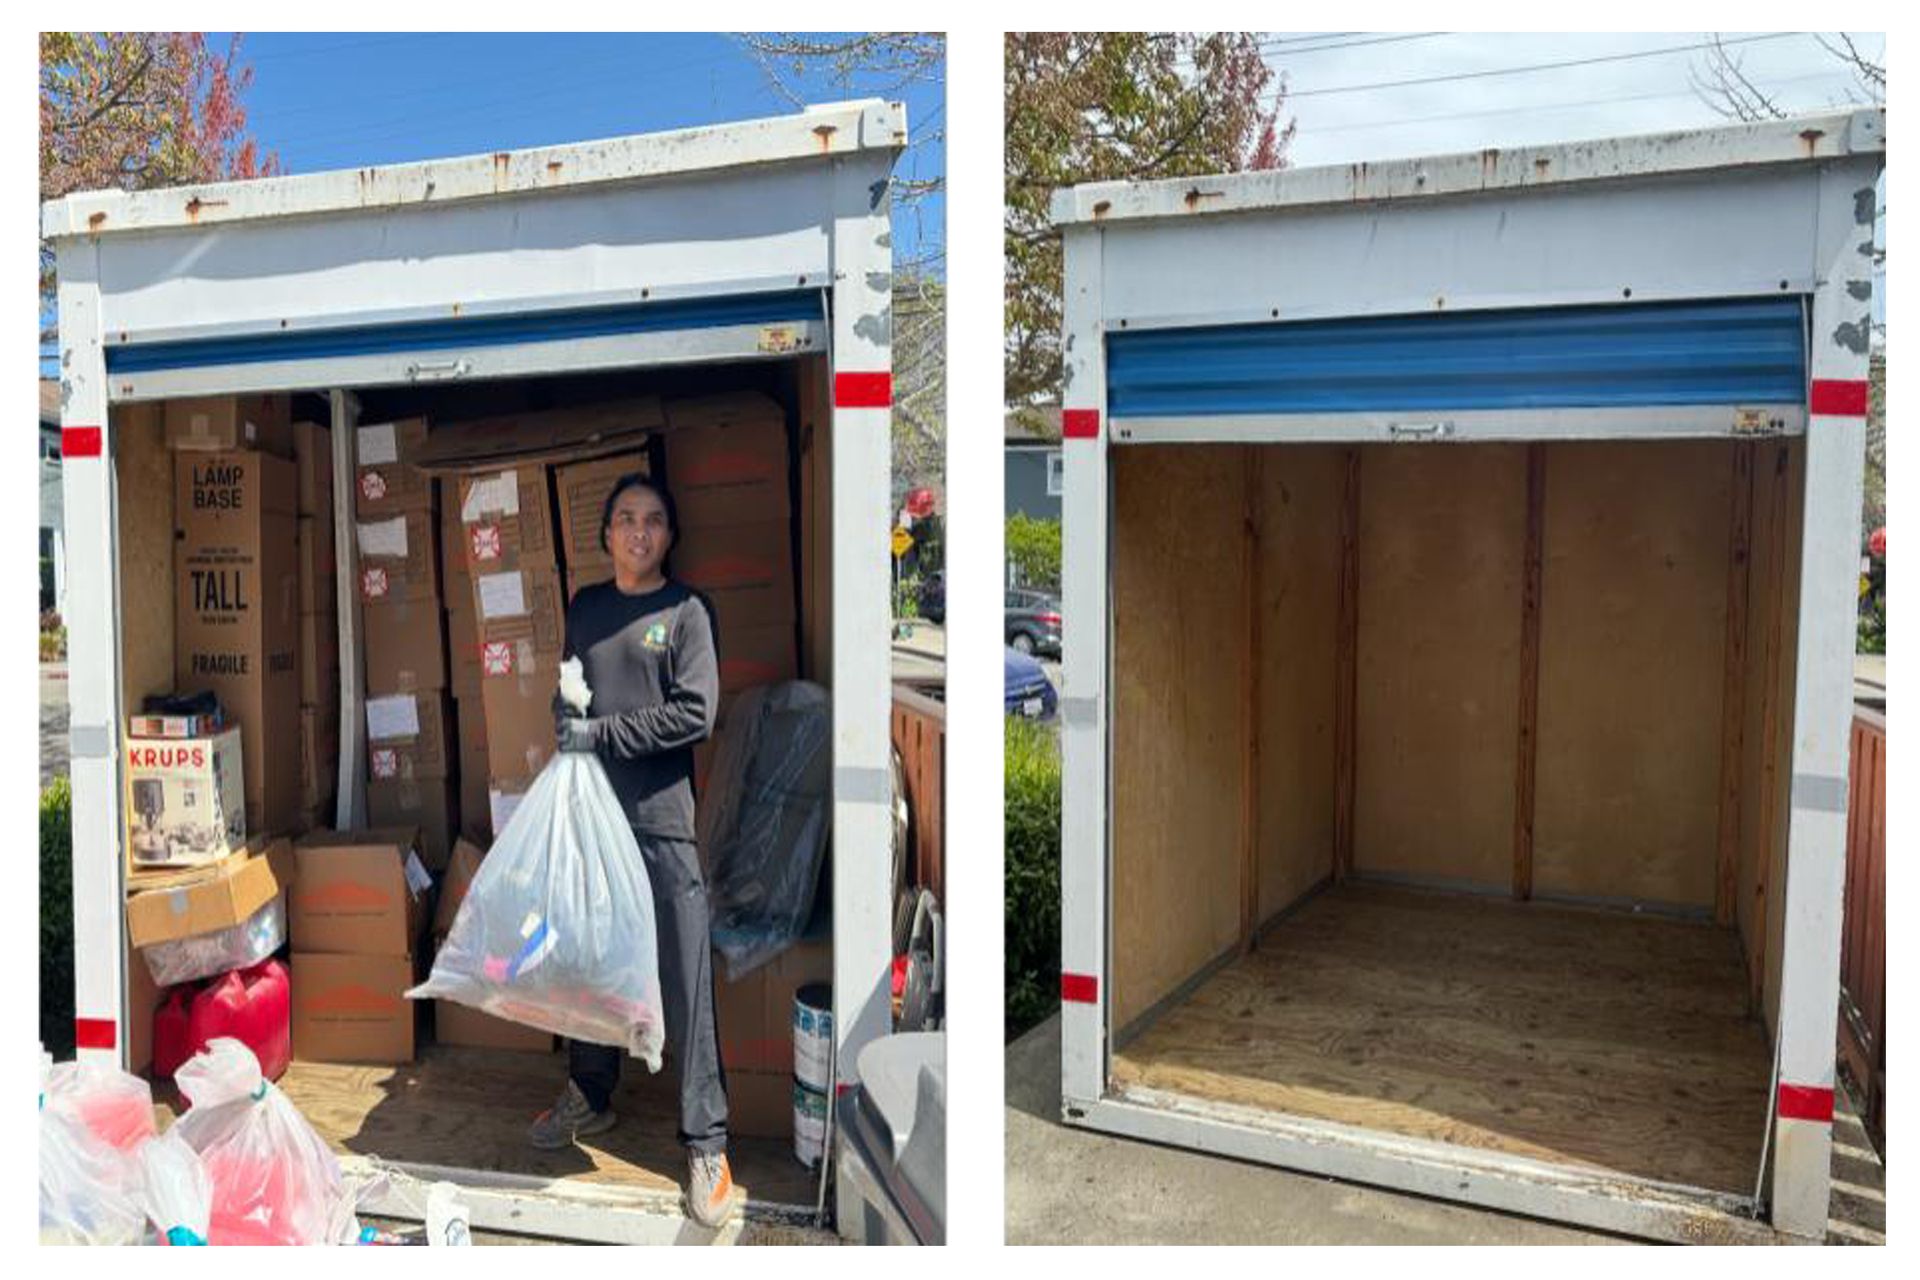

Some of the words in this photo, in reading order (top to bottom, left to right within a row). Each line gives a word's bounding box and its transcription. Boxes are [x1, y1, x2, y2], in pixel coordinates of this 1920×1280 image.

[193, 464, 244, 487] LAMP
[193, 488, 243, 509] BASE
[191, 570, 248, 610] TALL
[192, 654, 248, 674] FRAGILE
[129, 747, 204, 768] KRUPS
